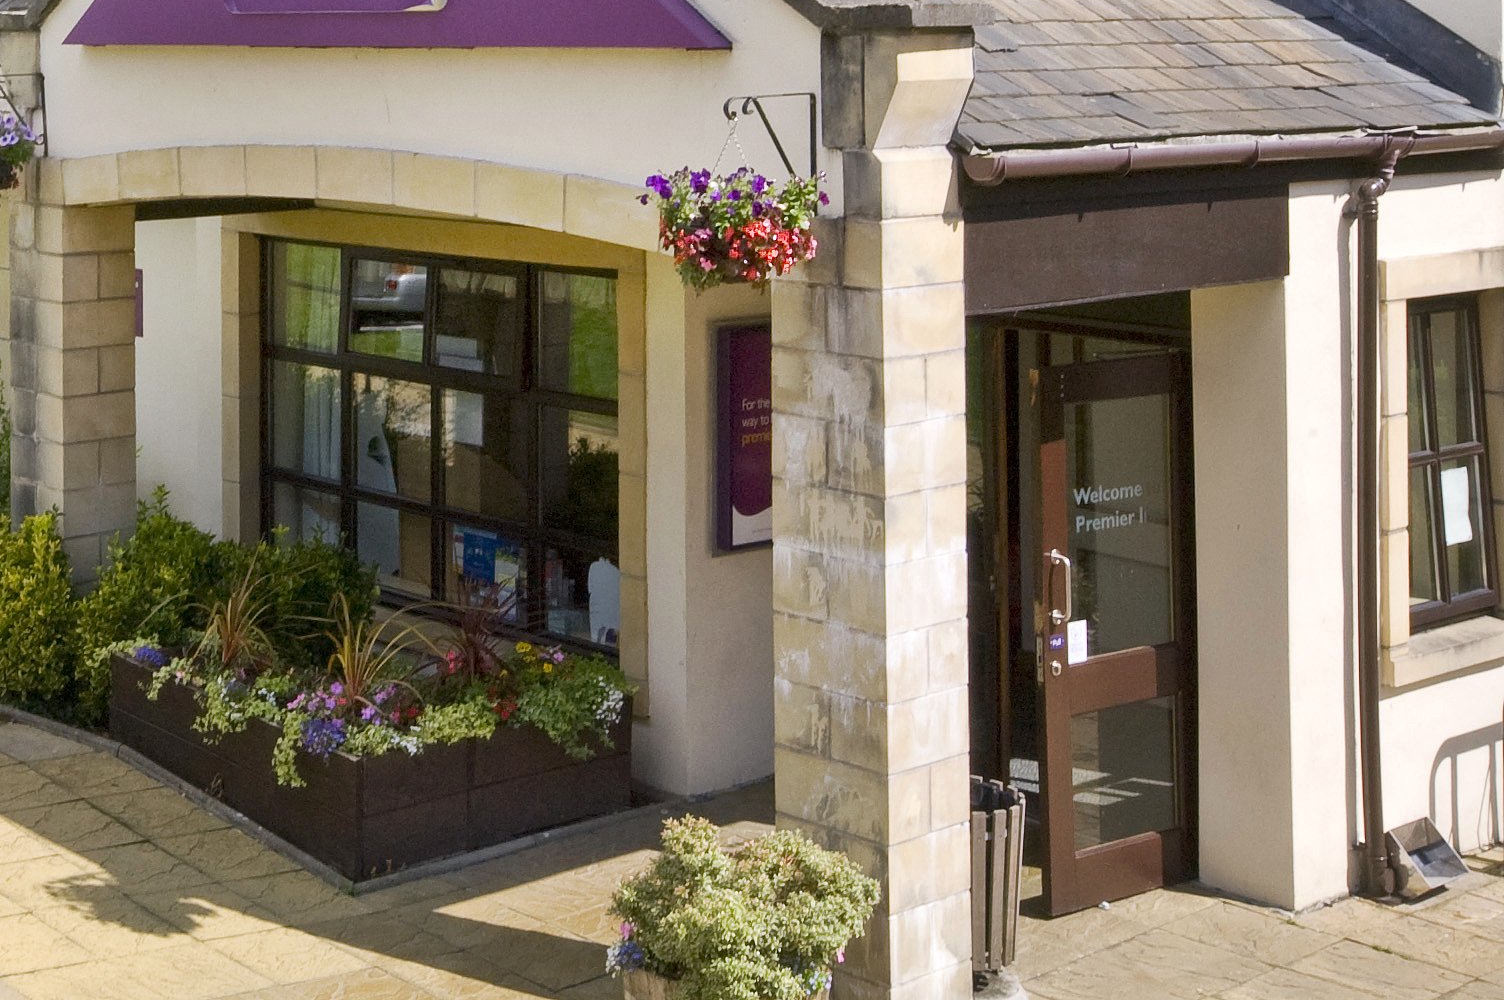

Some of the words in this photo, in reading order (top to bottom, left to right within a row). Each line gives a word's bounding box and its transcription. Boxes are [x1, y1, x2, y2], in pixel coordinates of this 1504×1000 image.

[742, 398, 756, 410] For
[742, 417, 758, 429] way
[760, 415, 769, 426] to
[1073, 484, 1143, 505] Welcome
[1076, 510, 1136, 533] Premier
